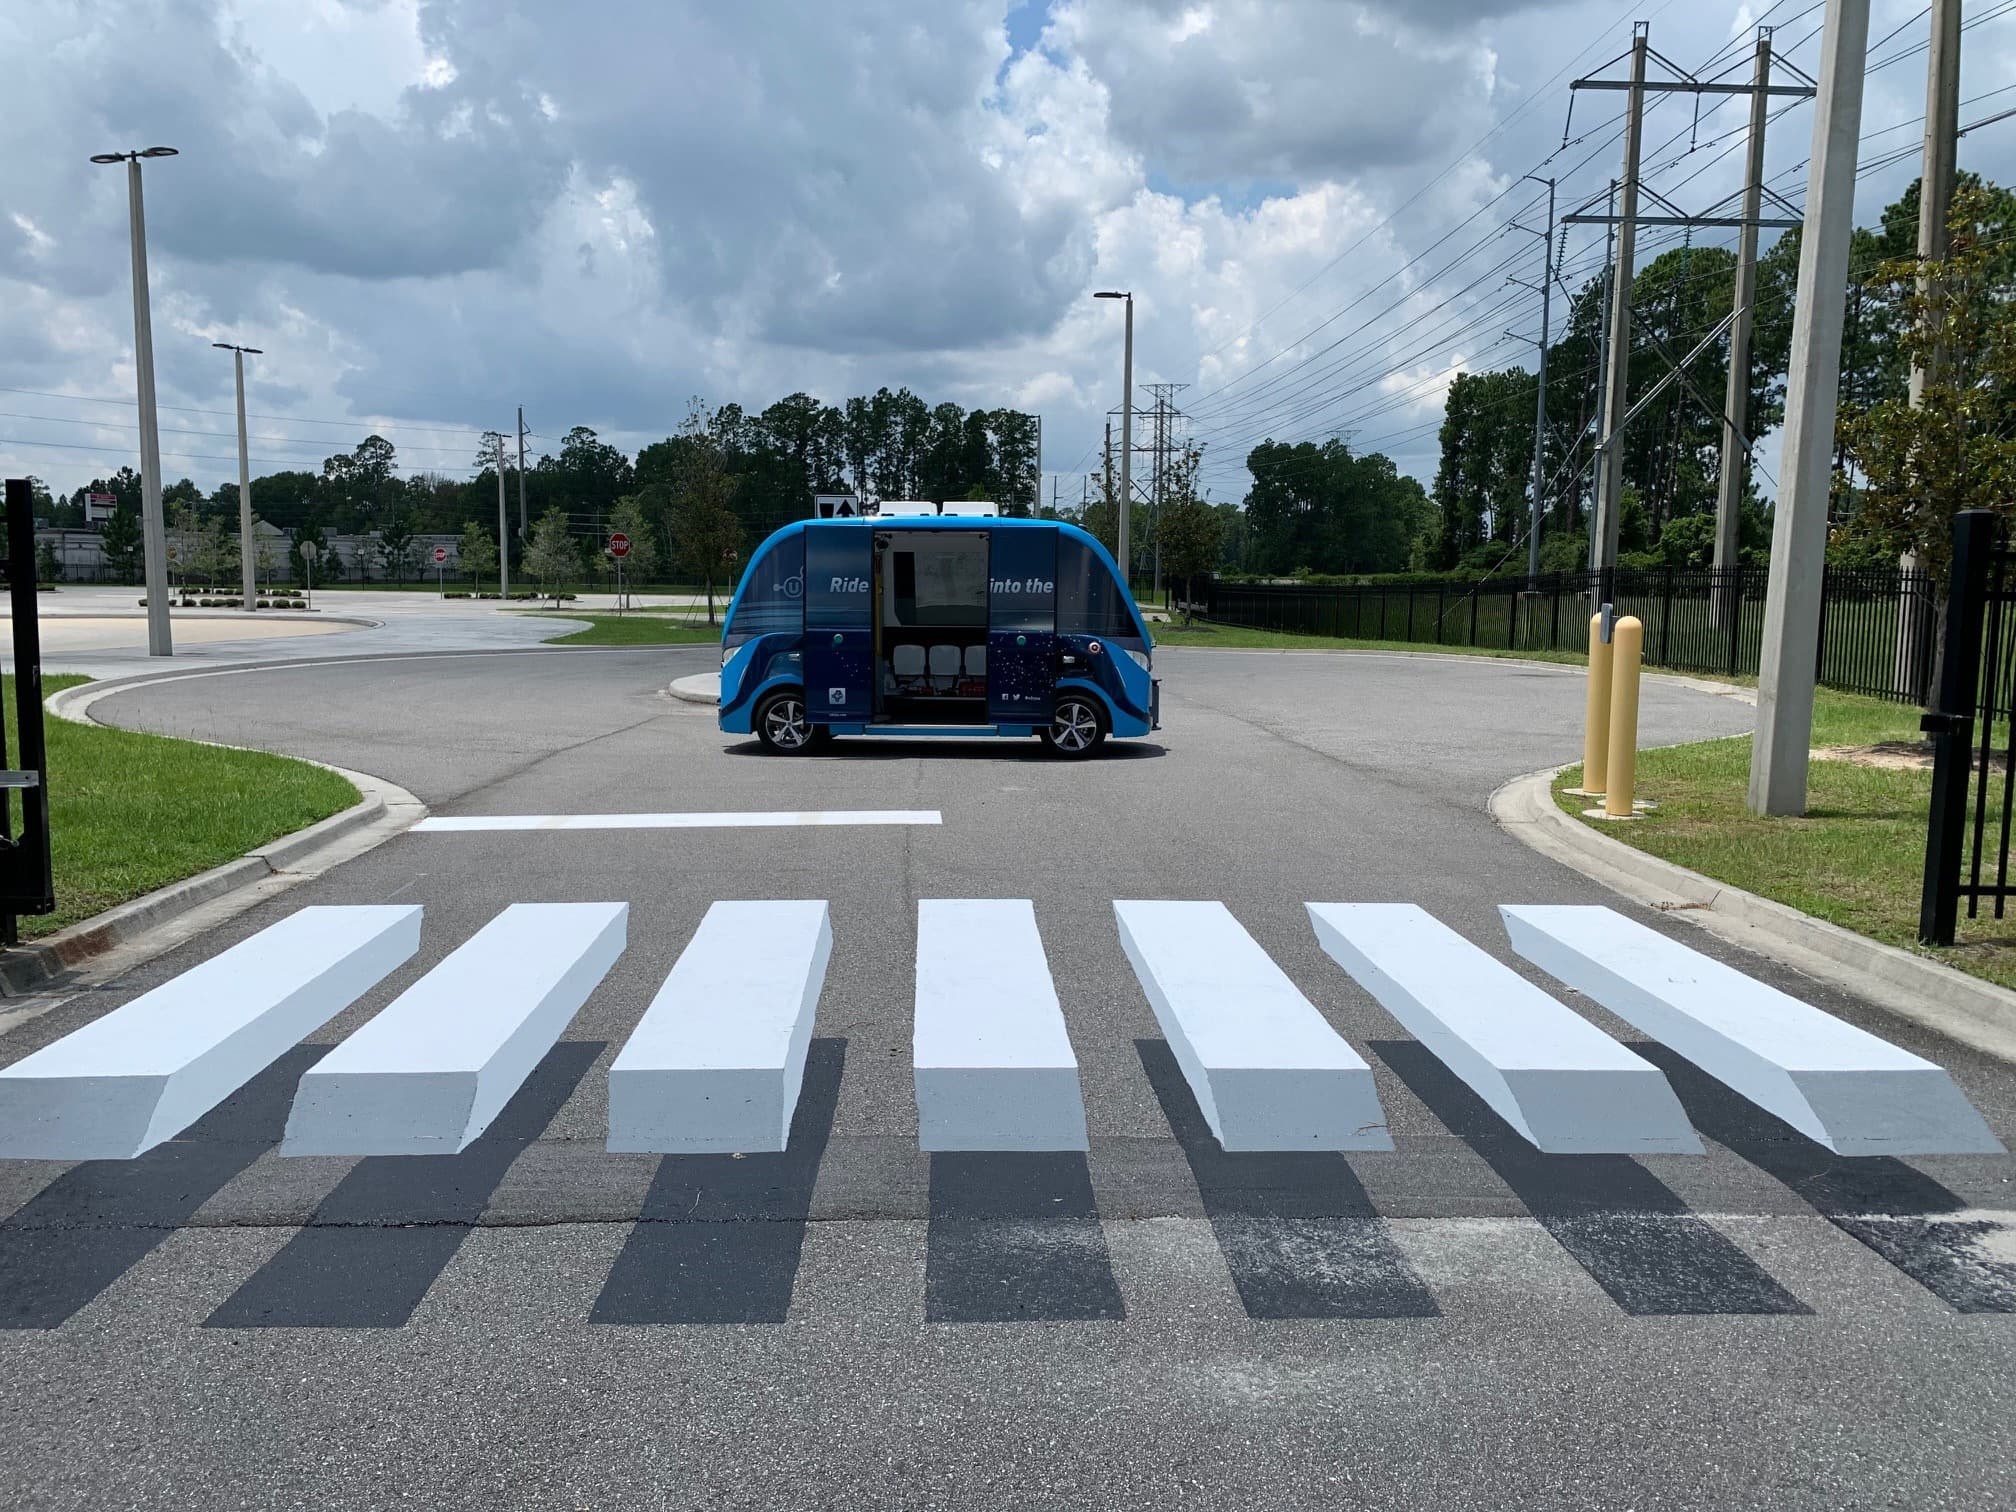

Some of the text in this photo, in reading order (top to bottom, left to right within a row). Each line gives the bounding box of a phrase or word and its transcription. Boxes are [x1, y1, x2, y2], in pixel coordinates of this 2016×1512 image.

[611, 540, 629, 550] STOP
[829, 577, 1054, 593] Ride into the
